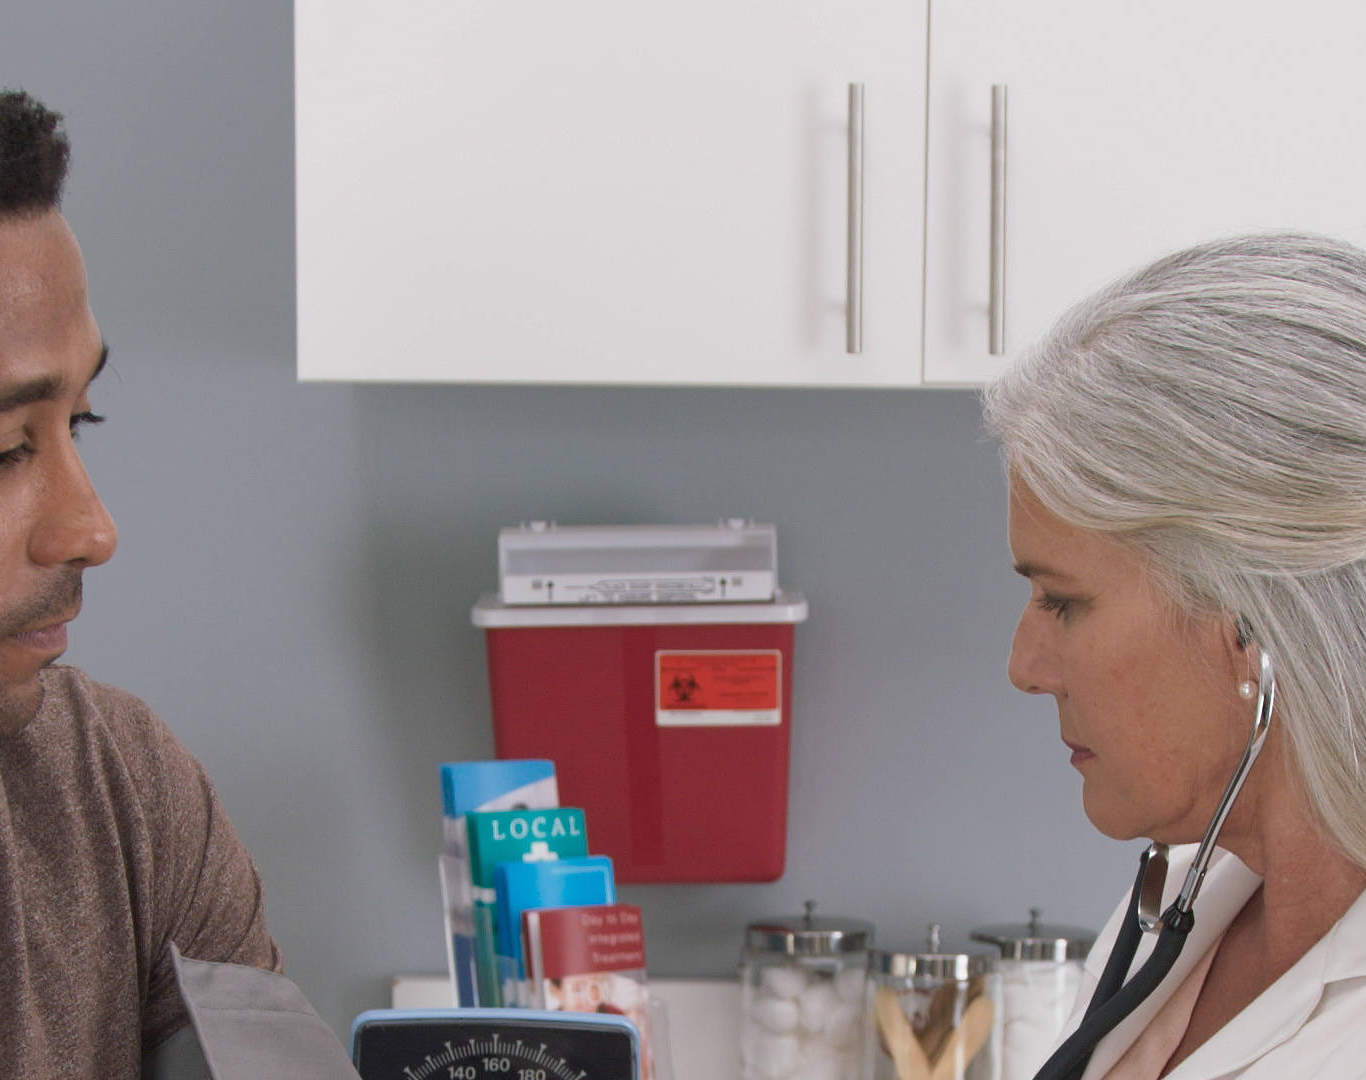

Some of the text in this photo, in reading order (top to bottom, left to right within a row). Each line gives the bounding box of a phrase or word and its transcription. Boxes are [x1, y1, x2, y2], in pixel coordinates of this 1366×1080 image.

[492, 816, 581, 841] LOCAL
[482, 1058, 510, 1072] 160
[448, 1066, 476, 1080] 140
